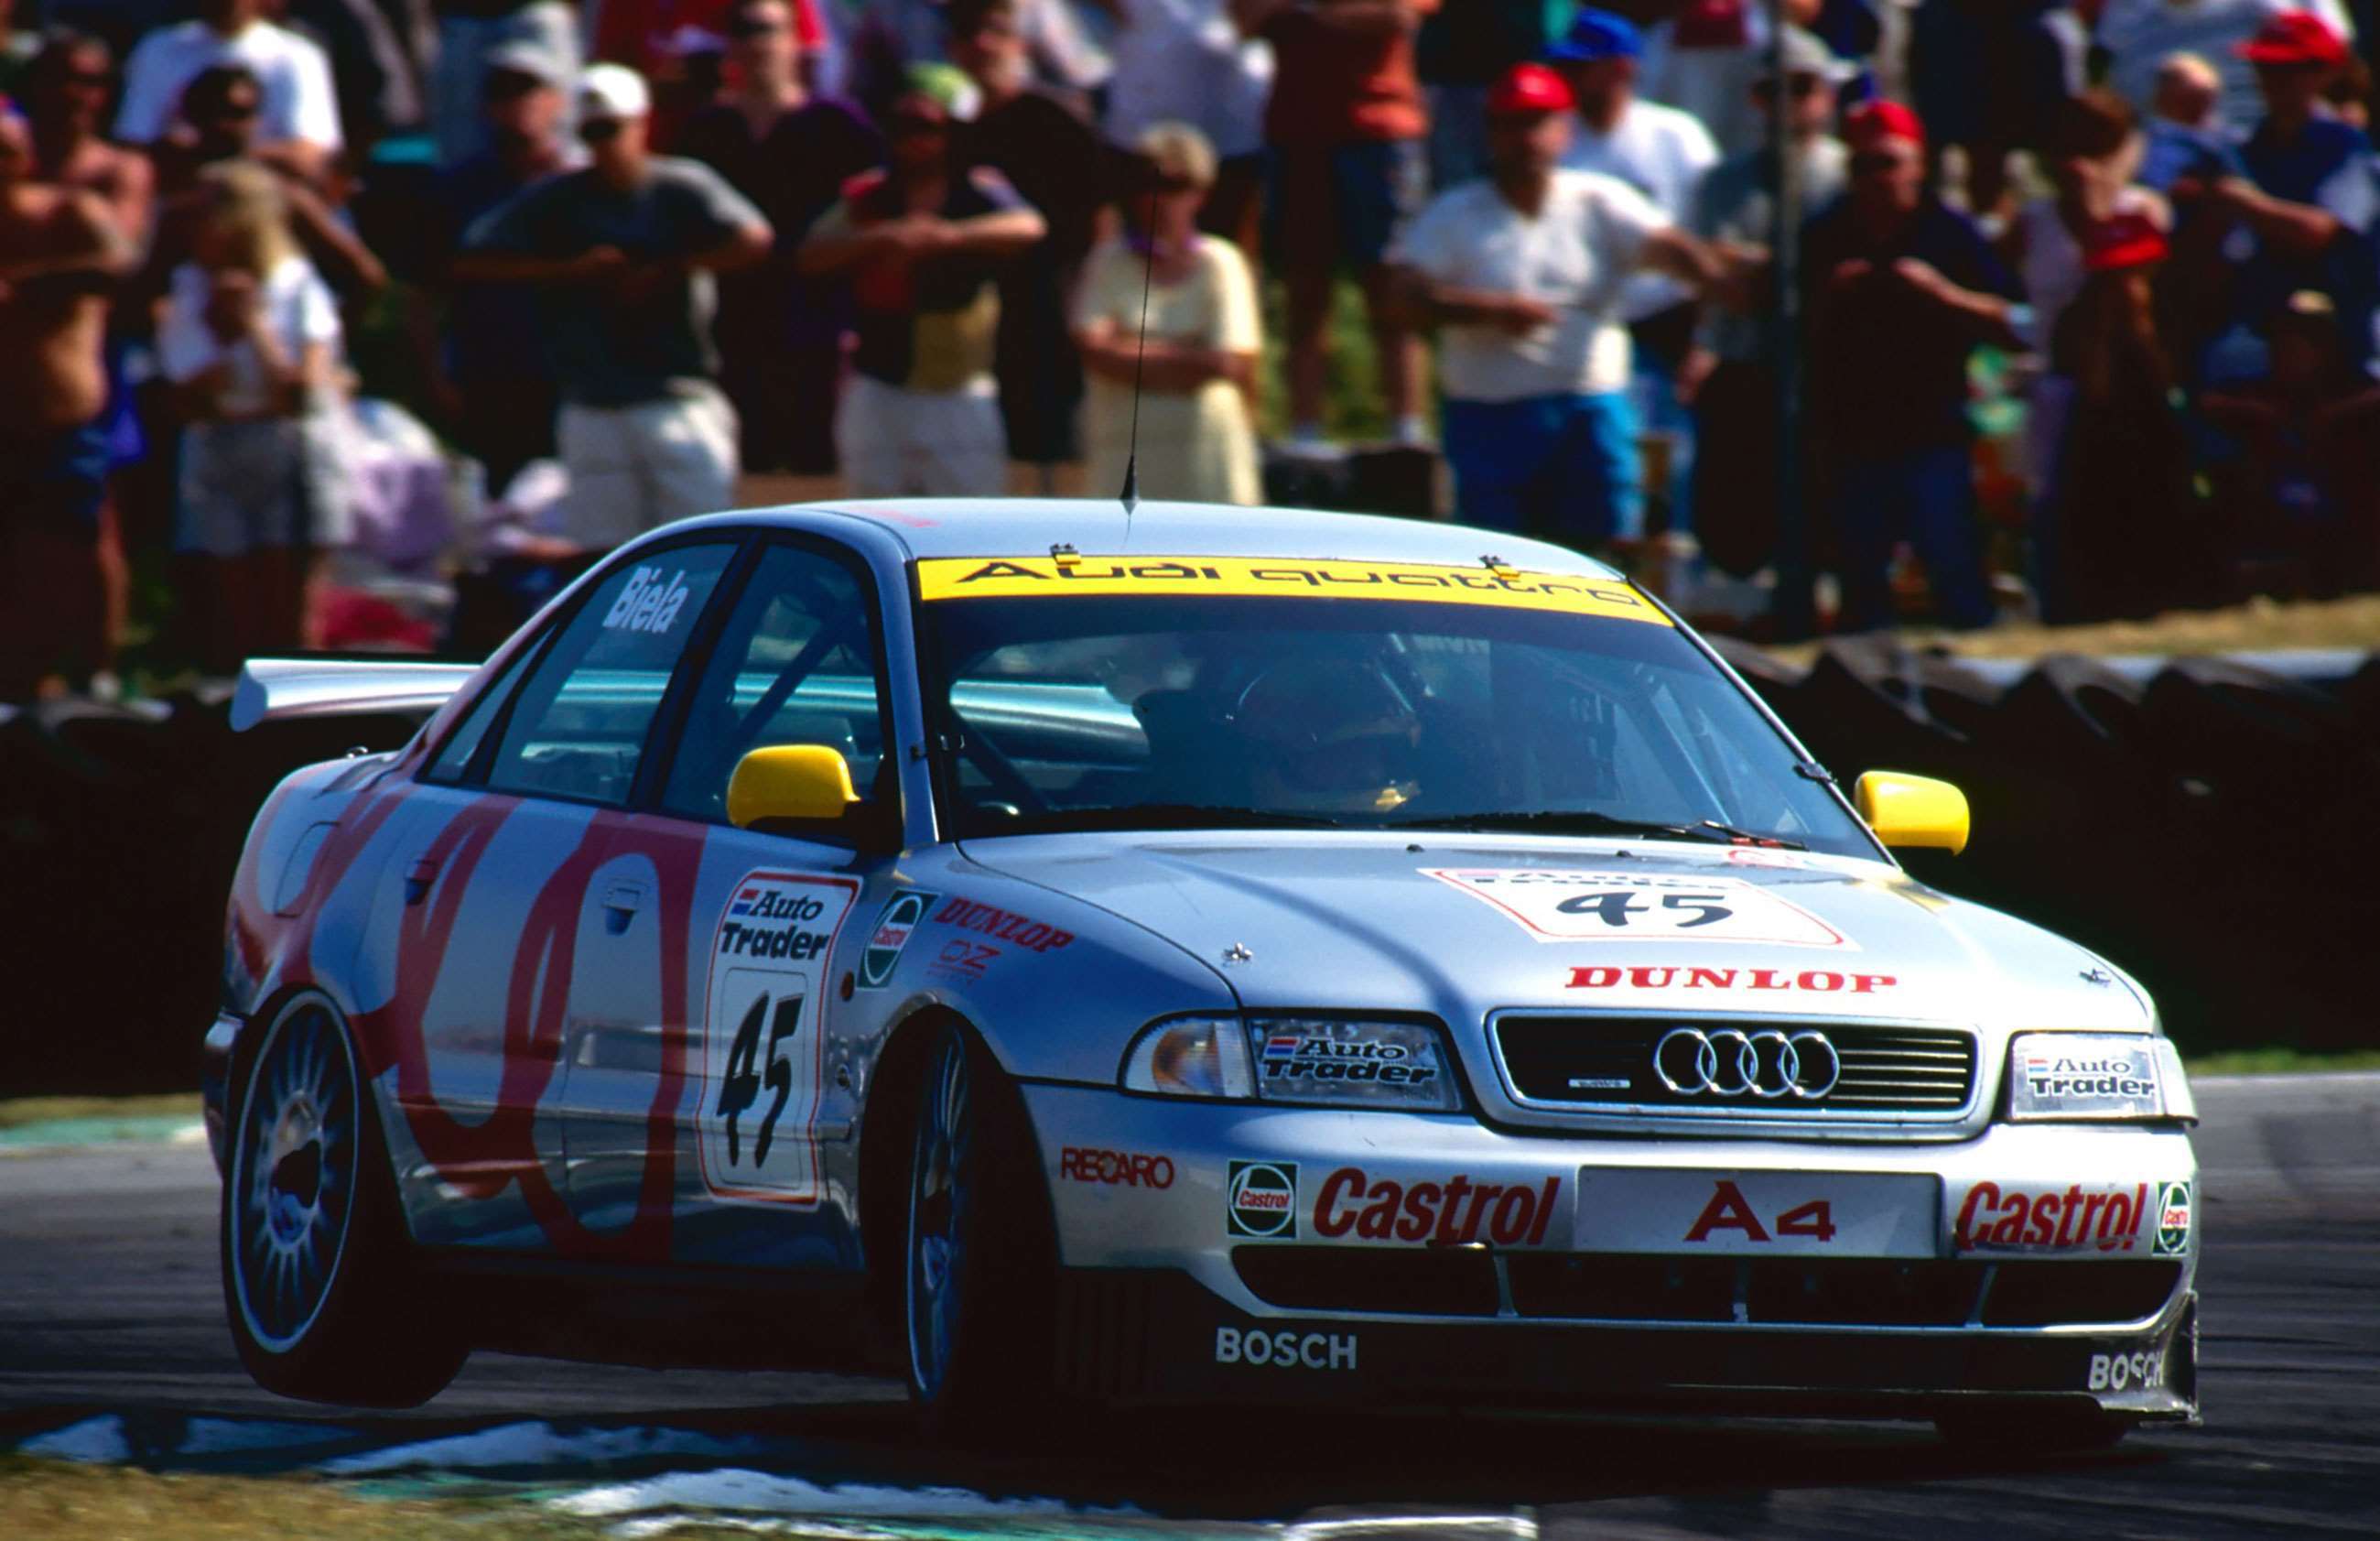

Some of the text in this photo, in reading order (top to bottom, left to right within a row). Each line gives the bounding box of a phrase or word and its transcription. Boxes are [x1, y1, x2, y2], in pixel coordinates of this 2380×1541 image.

[601, 567, 689, 633] Biela
[955, 561, 1642, 607] Audi quattro
[748, 890, 824, 921] Auto
[934, 897, 1076, 952] DUNLOP
[1556, 892, 1734, 928] 45
[720, 922, 829, 960] Trader
[1564, 966, 1897, 993] DUNLOP
[1295, 1038, 1406, 1059] Auto
[2052, 1058, 2131, 1074] Auto
[717, 990, 805, 1169] 45
[1263, 1058, 1434, 1084] Trader
[2028, 1076, 2155, 1095] Trader
[1060, 1147, 1174, 1188] RECARO
[1239, 1188, 1290, 1208] Castrol
[1313, 1167, 1561, 1246] Castrol
[1683, 1181, 1835, 1242] A4
[1954, 1180, 2148, 1252] Castrol
[1216, 1327, 1357, 1370] BOSCH
[2088, 1350, 2166, 1390] BOSCH
